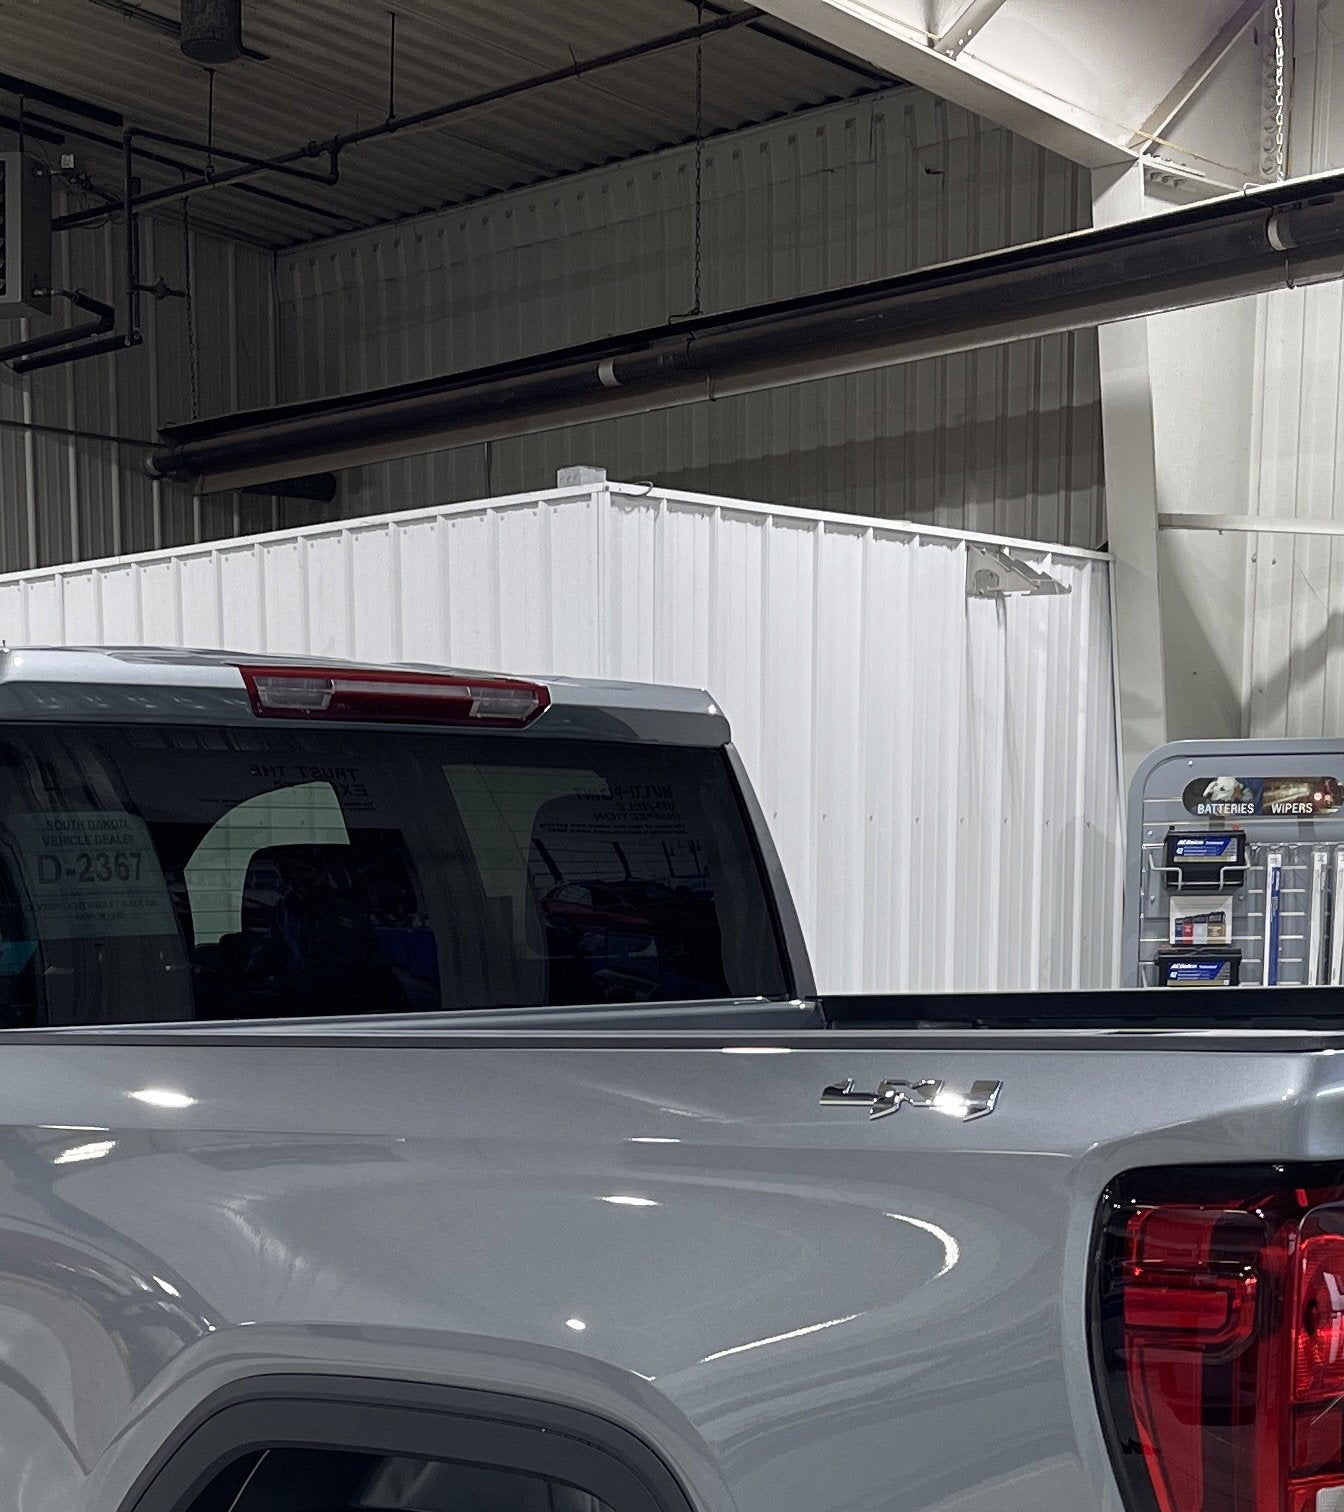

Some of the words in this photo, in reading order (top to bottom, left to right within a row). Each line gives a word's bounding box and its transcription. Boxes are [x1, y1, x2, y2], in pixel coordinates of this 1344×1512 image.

[1197, 802, 1255, 815] BATTERIES
[1271, 802, 1313, 814] WIPERS
[37, 852, 142, 885] D-2367
